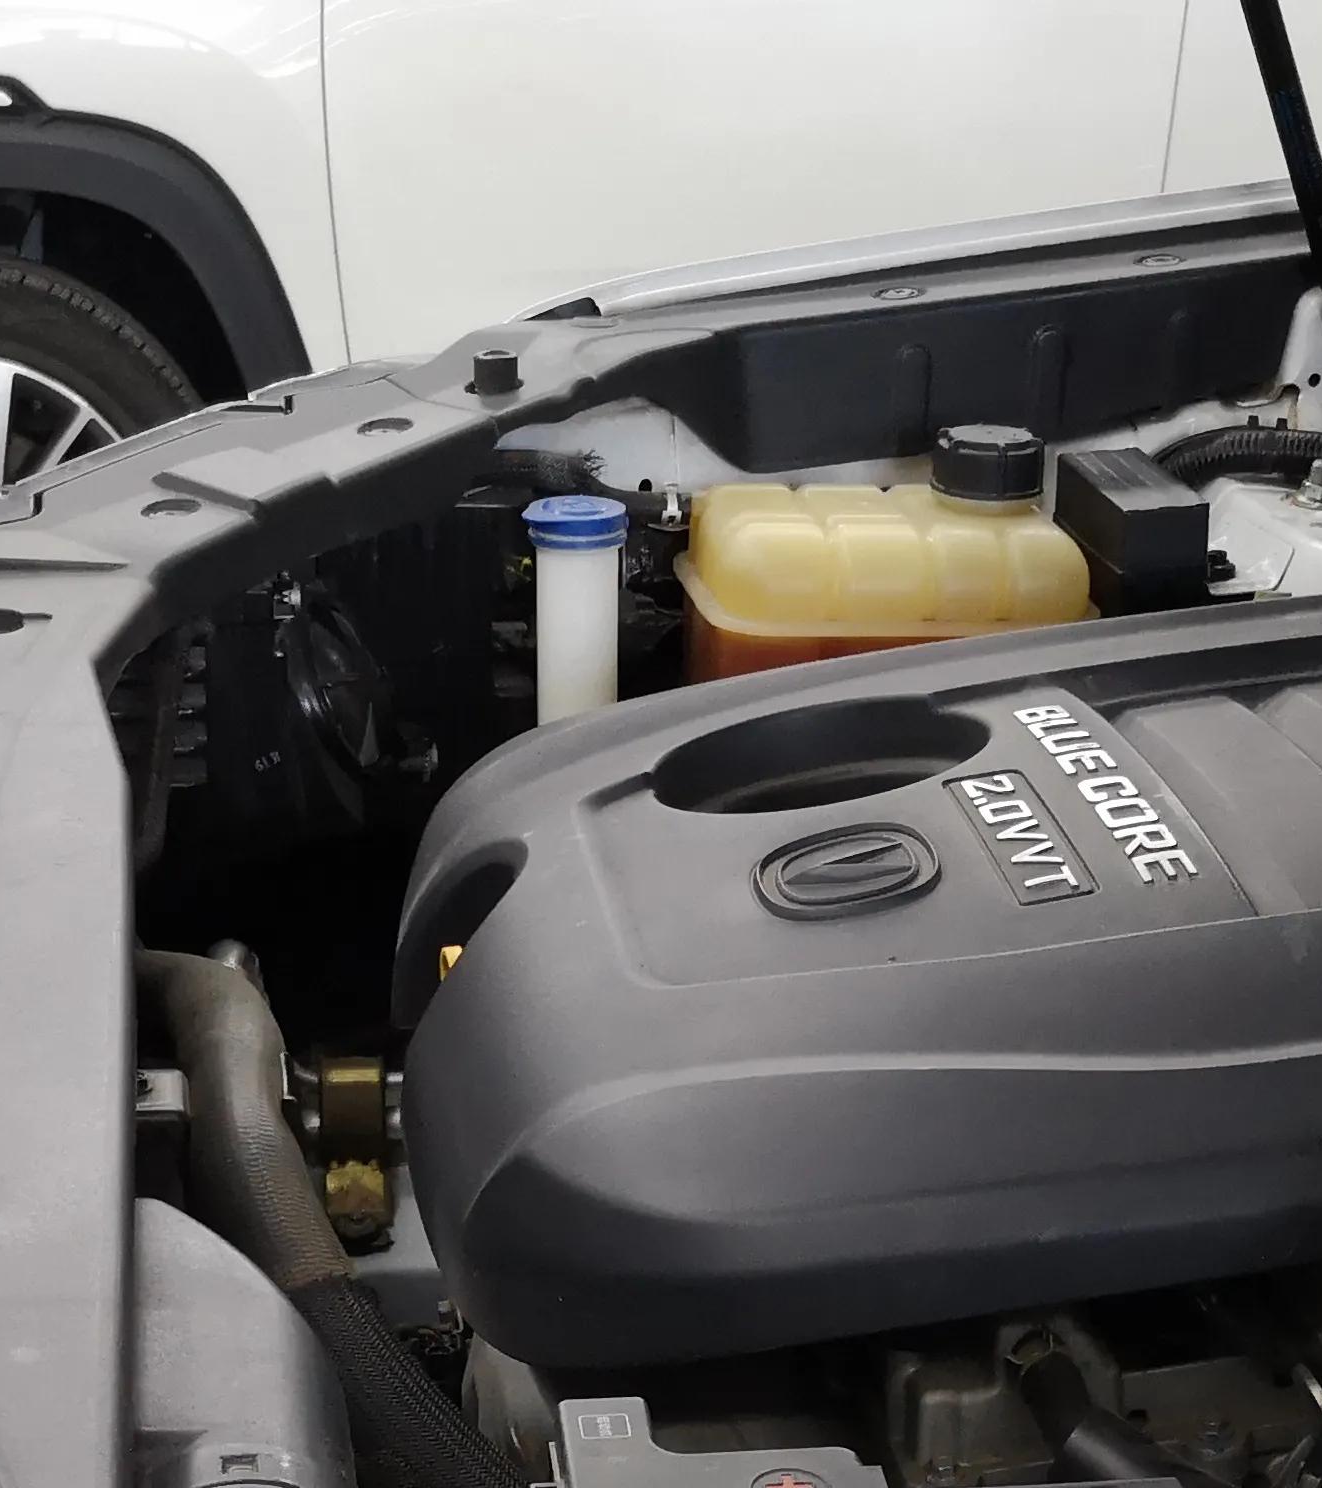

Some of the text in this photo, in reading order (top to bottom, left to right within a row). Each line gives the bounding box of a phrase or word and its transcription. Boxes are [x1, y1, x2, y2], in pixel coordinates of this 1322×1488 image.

[960, 774, 1080, 890] 2.0VVT
[1013, 705, 1199, 885] BLUE CORE
